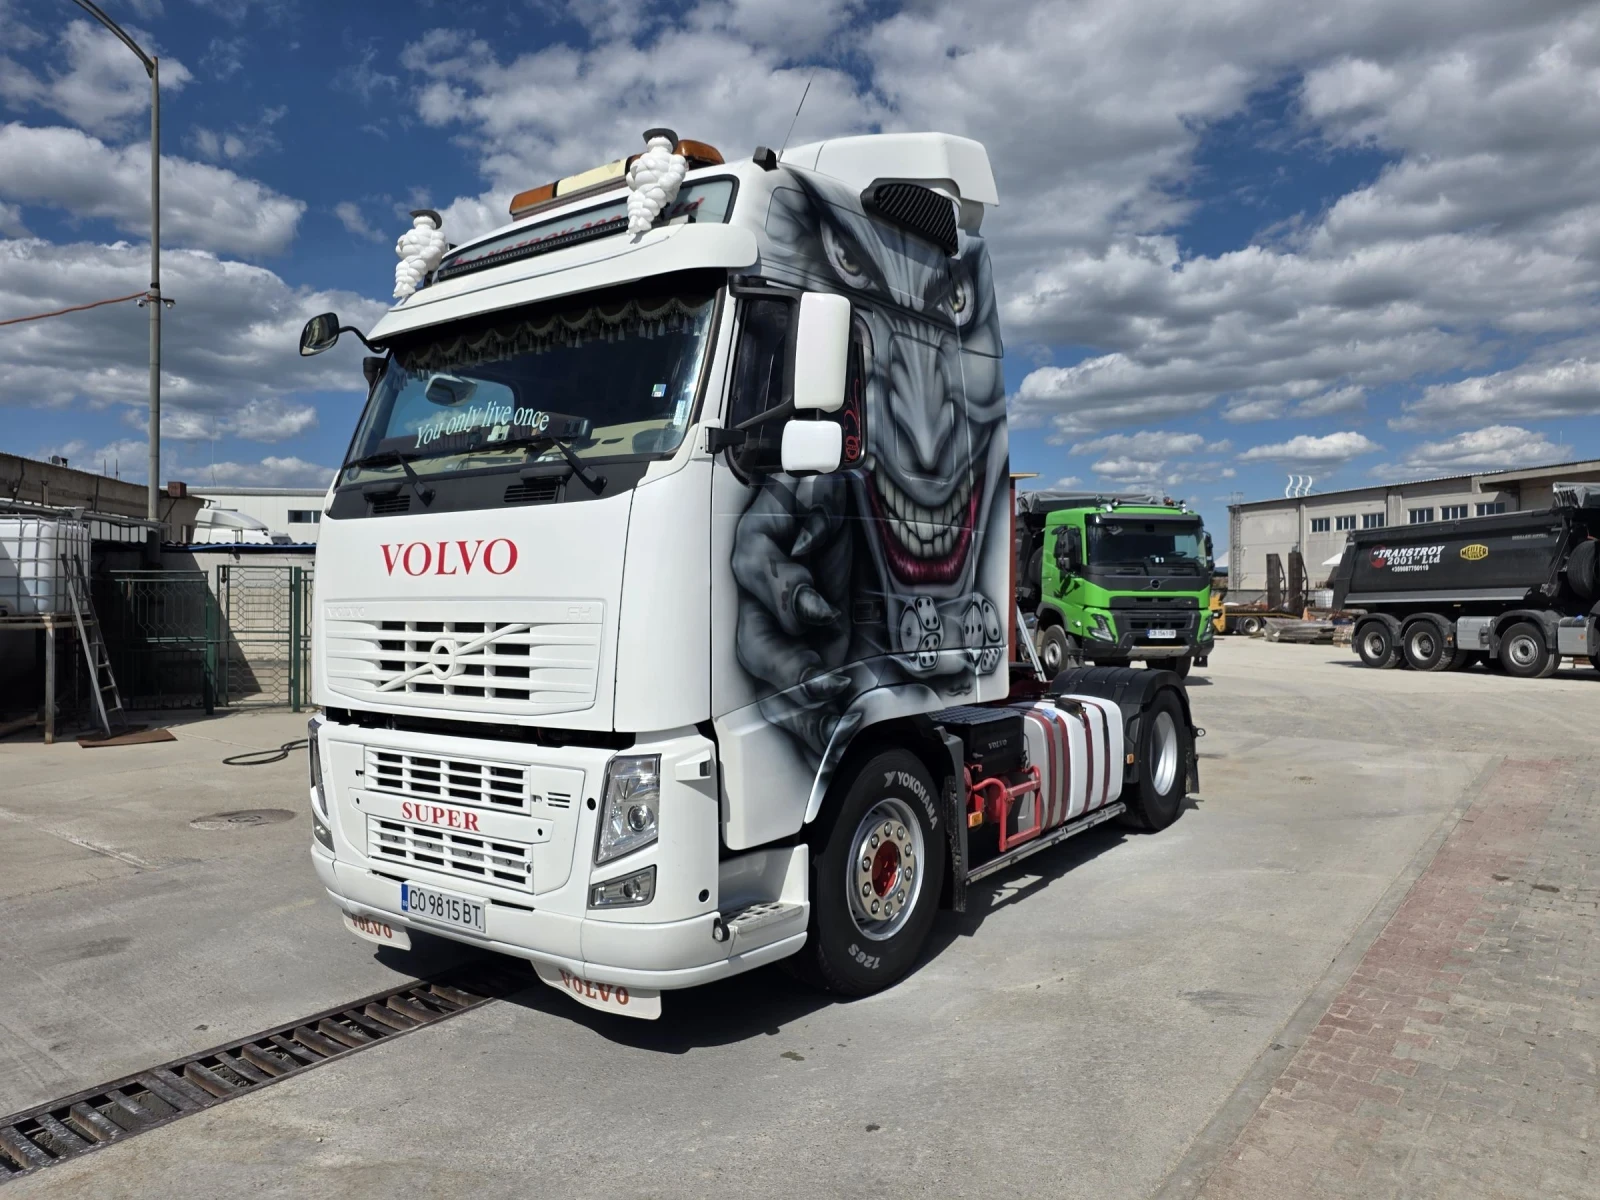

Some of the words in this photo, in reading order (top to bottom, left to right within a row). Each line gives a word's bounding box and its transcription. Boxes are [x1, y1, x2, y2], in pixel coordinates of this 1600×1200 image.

[414, 423, 443, 449] You
[446, 405, 482, 432] only
[480, 401, 512, 428] live
[513, 406, 550, 431] once
[380, 538, 518, 577] VOLVO
[1421, 555, 1441, 564] Ltd
[566, 606, 592, 620] FH
[988, 739, 1008, 750] VOLVO
[897, 771, 938, 830] YOKOHAMA
[402, 801, 480, 832] SUPER
[428, 894, 460, 921] 9815
[463, 901, 481, 927] BT
[351, 914, 393, 939] VOLVO
[848, 943, 880, 970] 126S
[559, 969, 630, 1005] VOLVO
